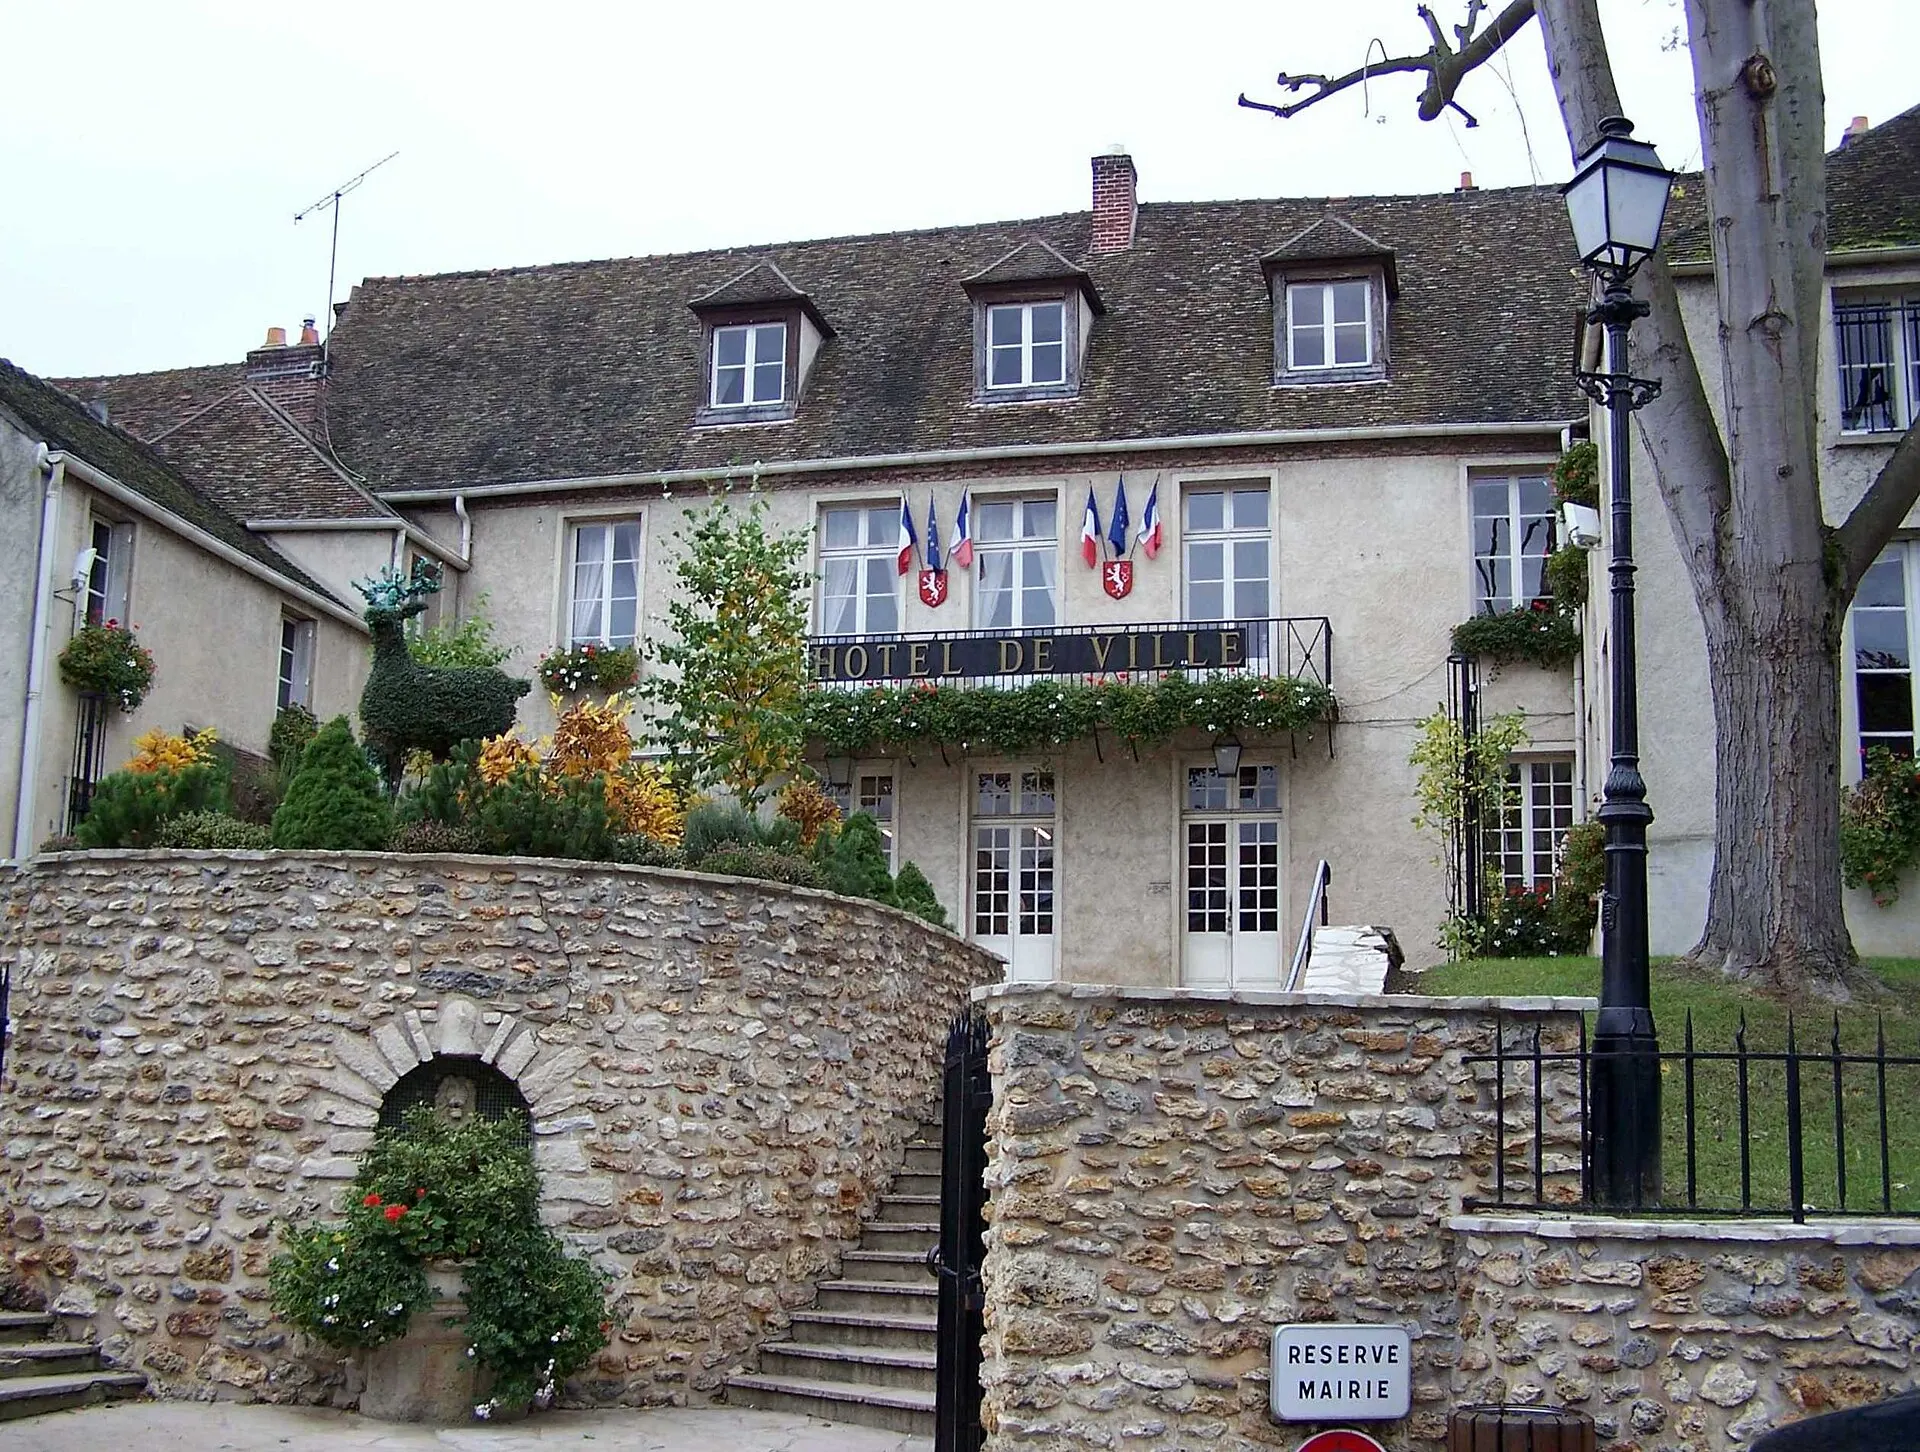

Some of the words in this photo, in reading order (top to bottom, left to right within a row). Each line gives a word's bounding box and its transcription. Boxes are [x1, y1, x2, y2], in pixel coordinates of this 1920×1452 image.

[813, 642, 965, 680] HOTEL
[998, 639, 1055, 673] DE
[1089, 632, 1243, 669] VILLE
[1299, 1380, 1389, 1399] MAIRIE
